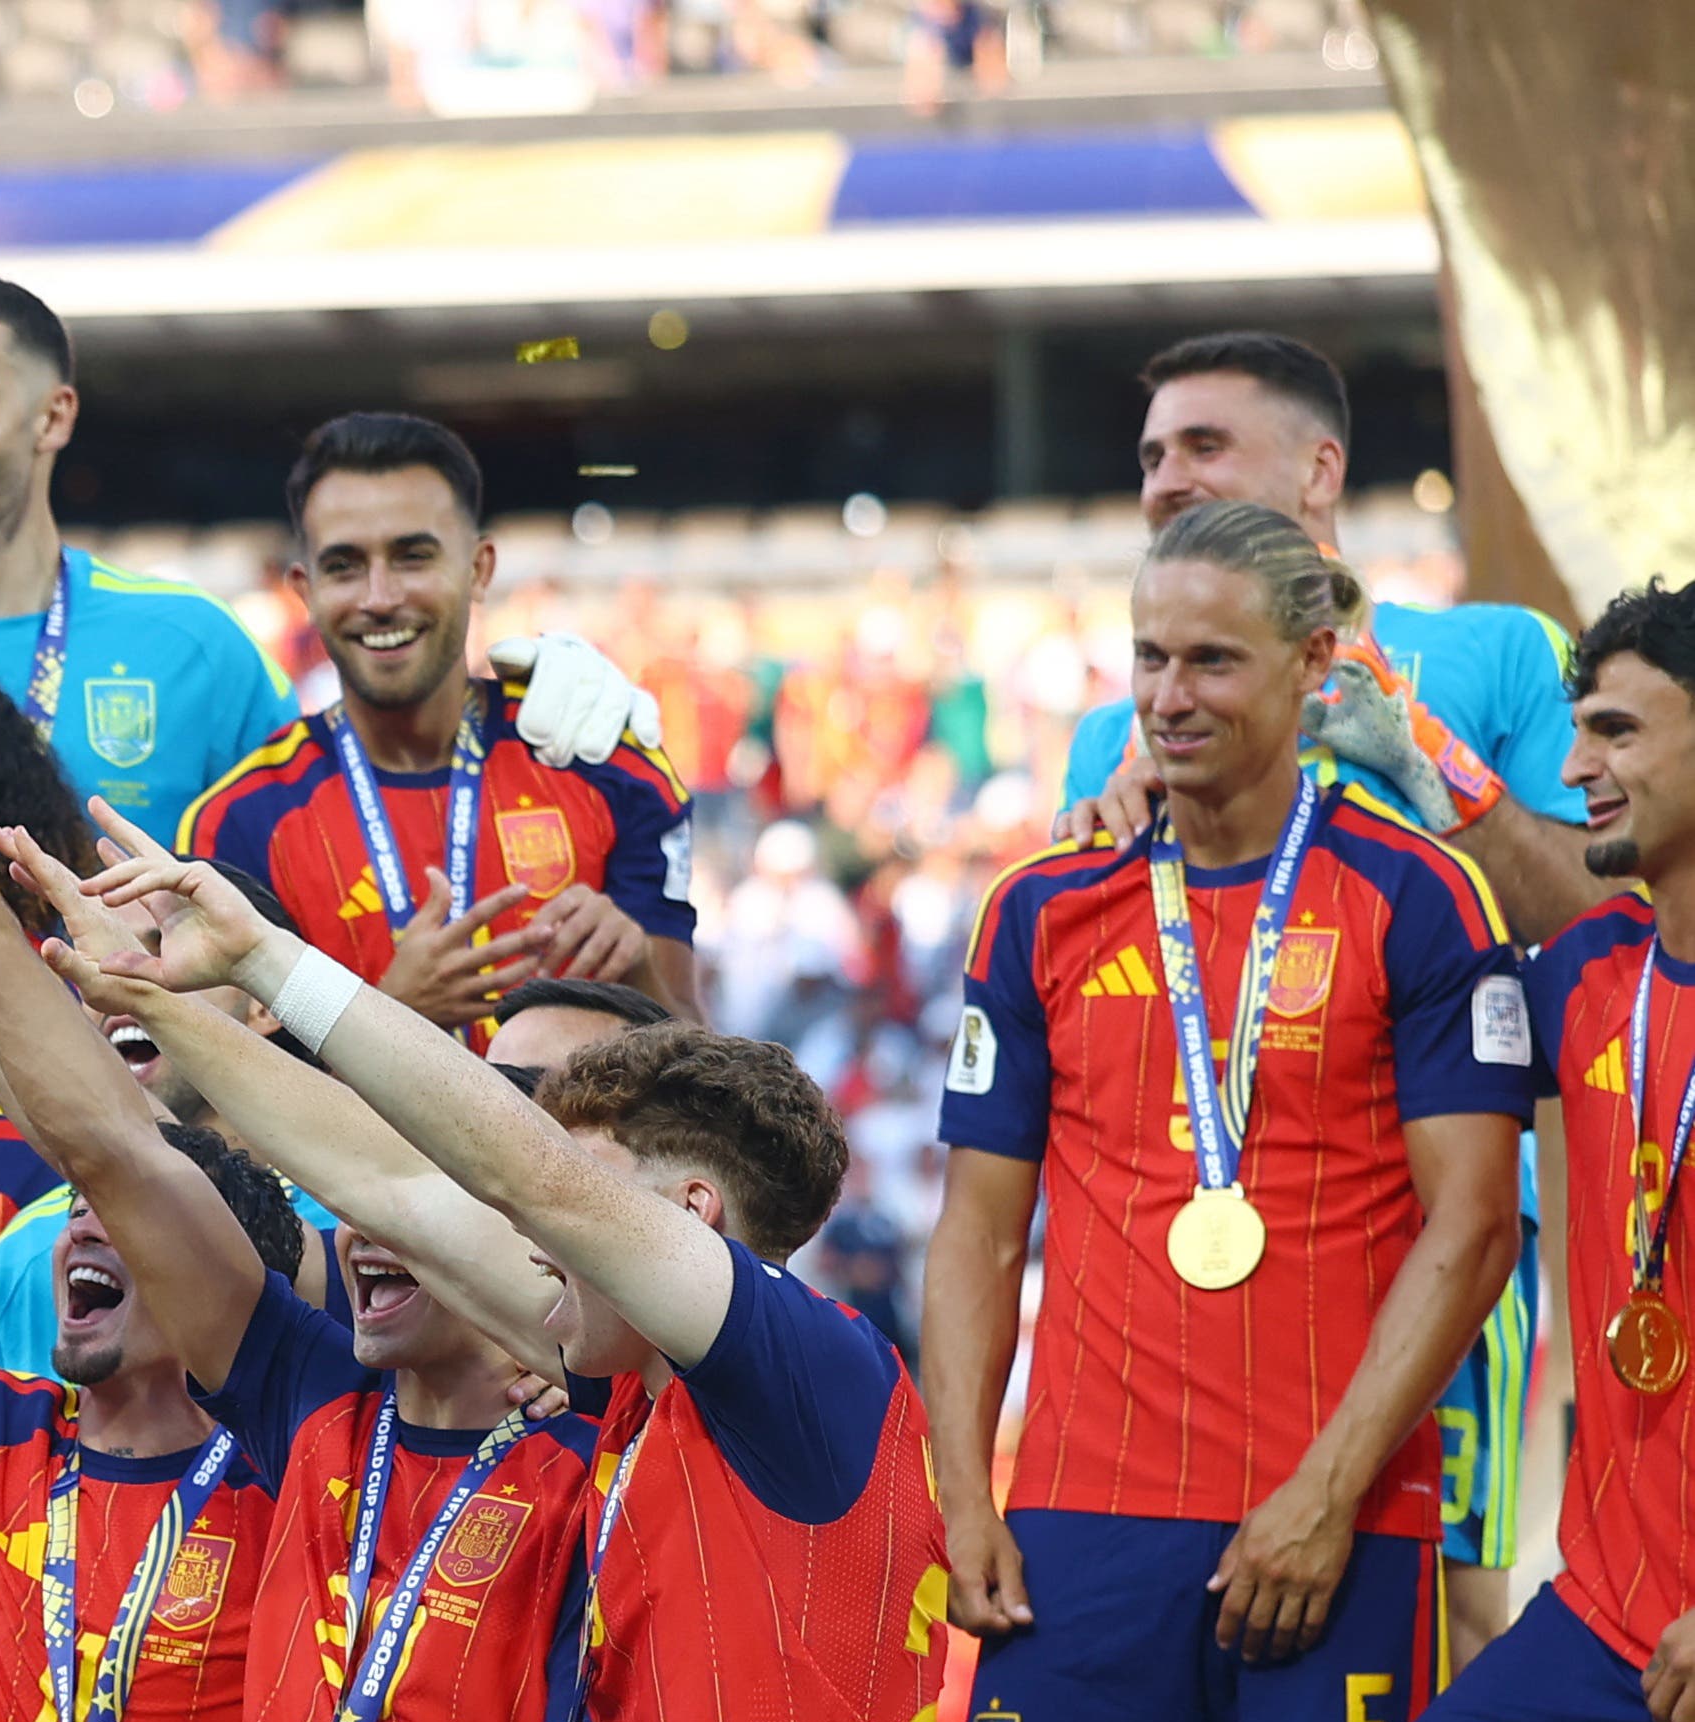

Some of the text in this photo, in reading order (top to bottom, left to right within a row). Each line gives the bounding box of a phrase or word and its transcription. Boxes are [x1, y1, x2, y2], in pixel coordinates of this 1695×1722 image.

[351, 765, 379, 820] WORLD
[452, 786, 473, 846] 2026
[368, 820, 389, 851] CUP
[1282, 802, 1312, 860] WORLD
[378, 852, 407, 912] 2026
[451, 847, 467, 883] CUP
[1271, 860, 1294, 895] FIFA
[1182, 1015, 1201, 1054] FIFA
[1189, 1054, 1212, 1117] WORLD
[1199, 1117, 1218, 1153] CUP
[193, 1434, 231, 1486] 2026
[354, 1408, 395, 1574] WORLD CUP 2026
[362, 1487, 470, 1697] FIFA WORLD CUP 2026
[56, 1665, 69, 1707] FIFA
